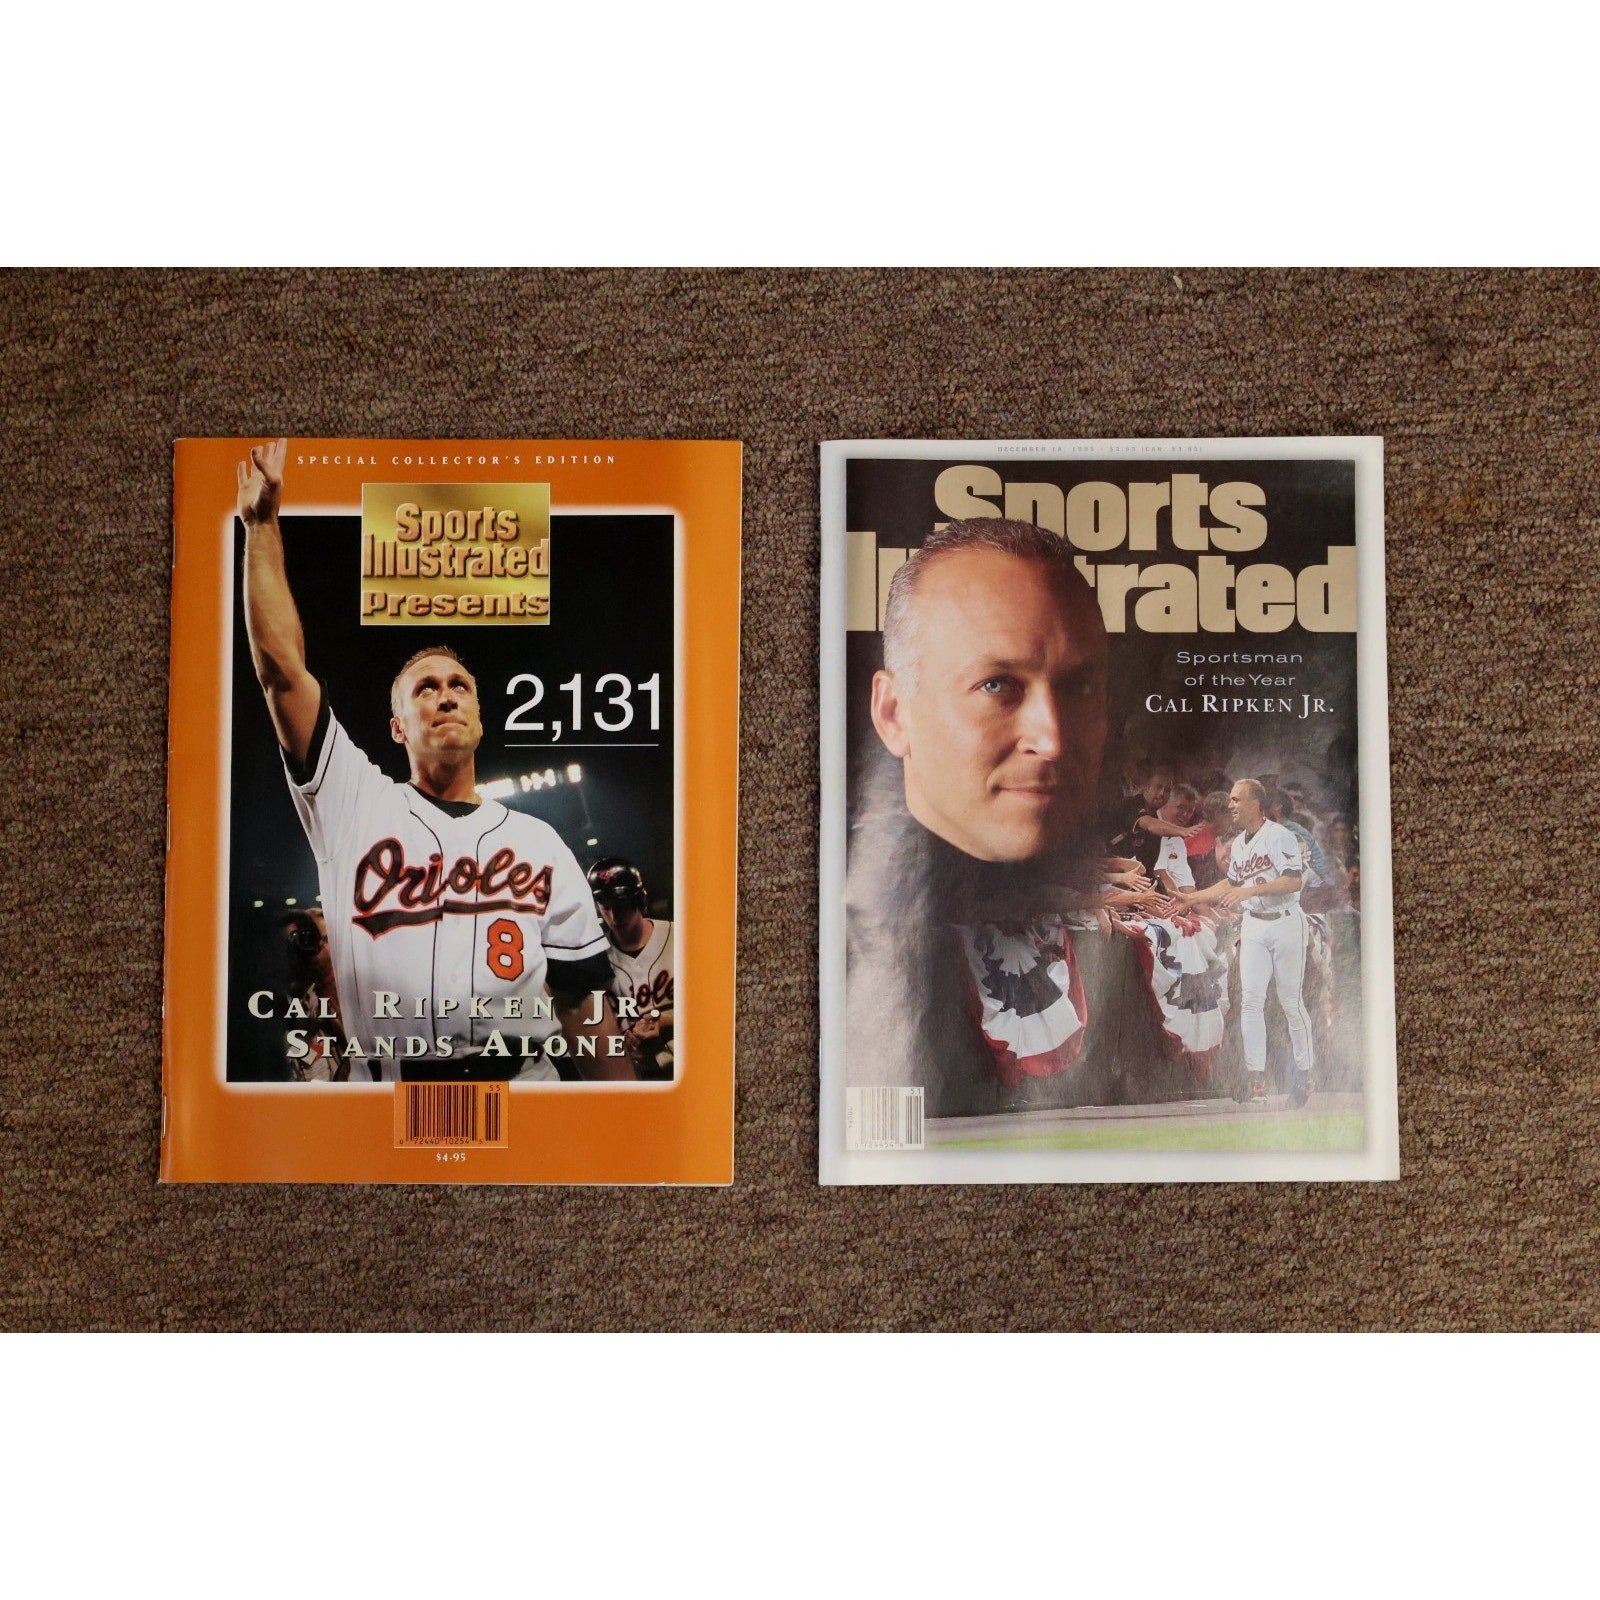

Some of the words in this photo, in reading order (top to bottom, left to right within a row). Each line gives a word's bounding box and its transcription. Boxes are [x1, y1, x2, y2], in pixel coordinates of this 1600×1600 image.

[297, 455, 377, 465] SPECIAL
[392, 455, 521, 465] COLLECTOR'S
[535, 455, 616, 465] EDITION
[395, 502, 519, 546] Sports
[362, 533, 550, 578] Illustrated
[846, 531, 1358, 633] Irated
[362, 590, 549, 617] Presents
[1176, 651, 1303, 666] Sportsman
[1184, 674, 1205, 686] of
[1212, 674, 1246, 686] the
[1248, 674, 1296, 686] Year
[504, 672, 661, 742] 2,131
[1145, 694, 1193, 713] CAL
[1201, 694, 1293, 713] RIPKEN
[1298, 694, 1335, 719] JR.
[354, 837, 553, 916] Orioles
[487, 918, 524, 981] 8
[247, 990, 339, 1020] CAL
[372, 990, 556, 1020] RIPKEN
[582, 990, 661, 1026] JR.
[286, 1029, 455, 1059] STANDS
[480, 1029, 627, 1059] ALONE
[413, 1137, 440, 1145] 72440
[444, 1137, 470, 1145] 10254
